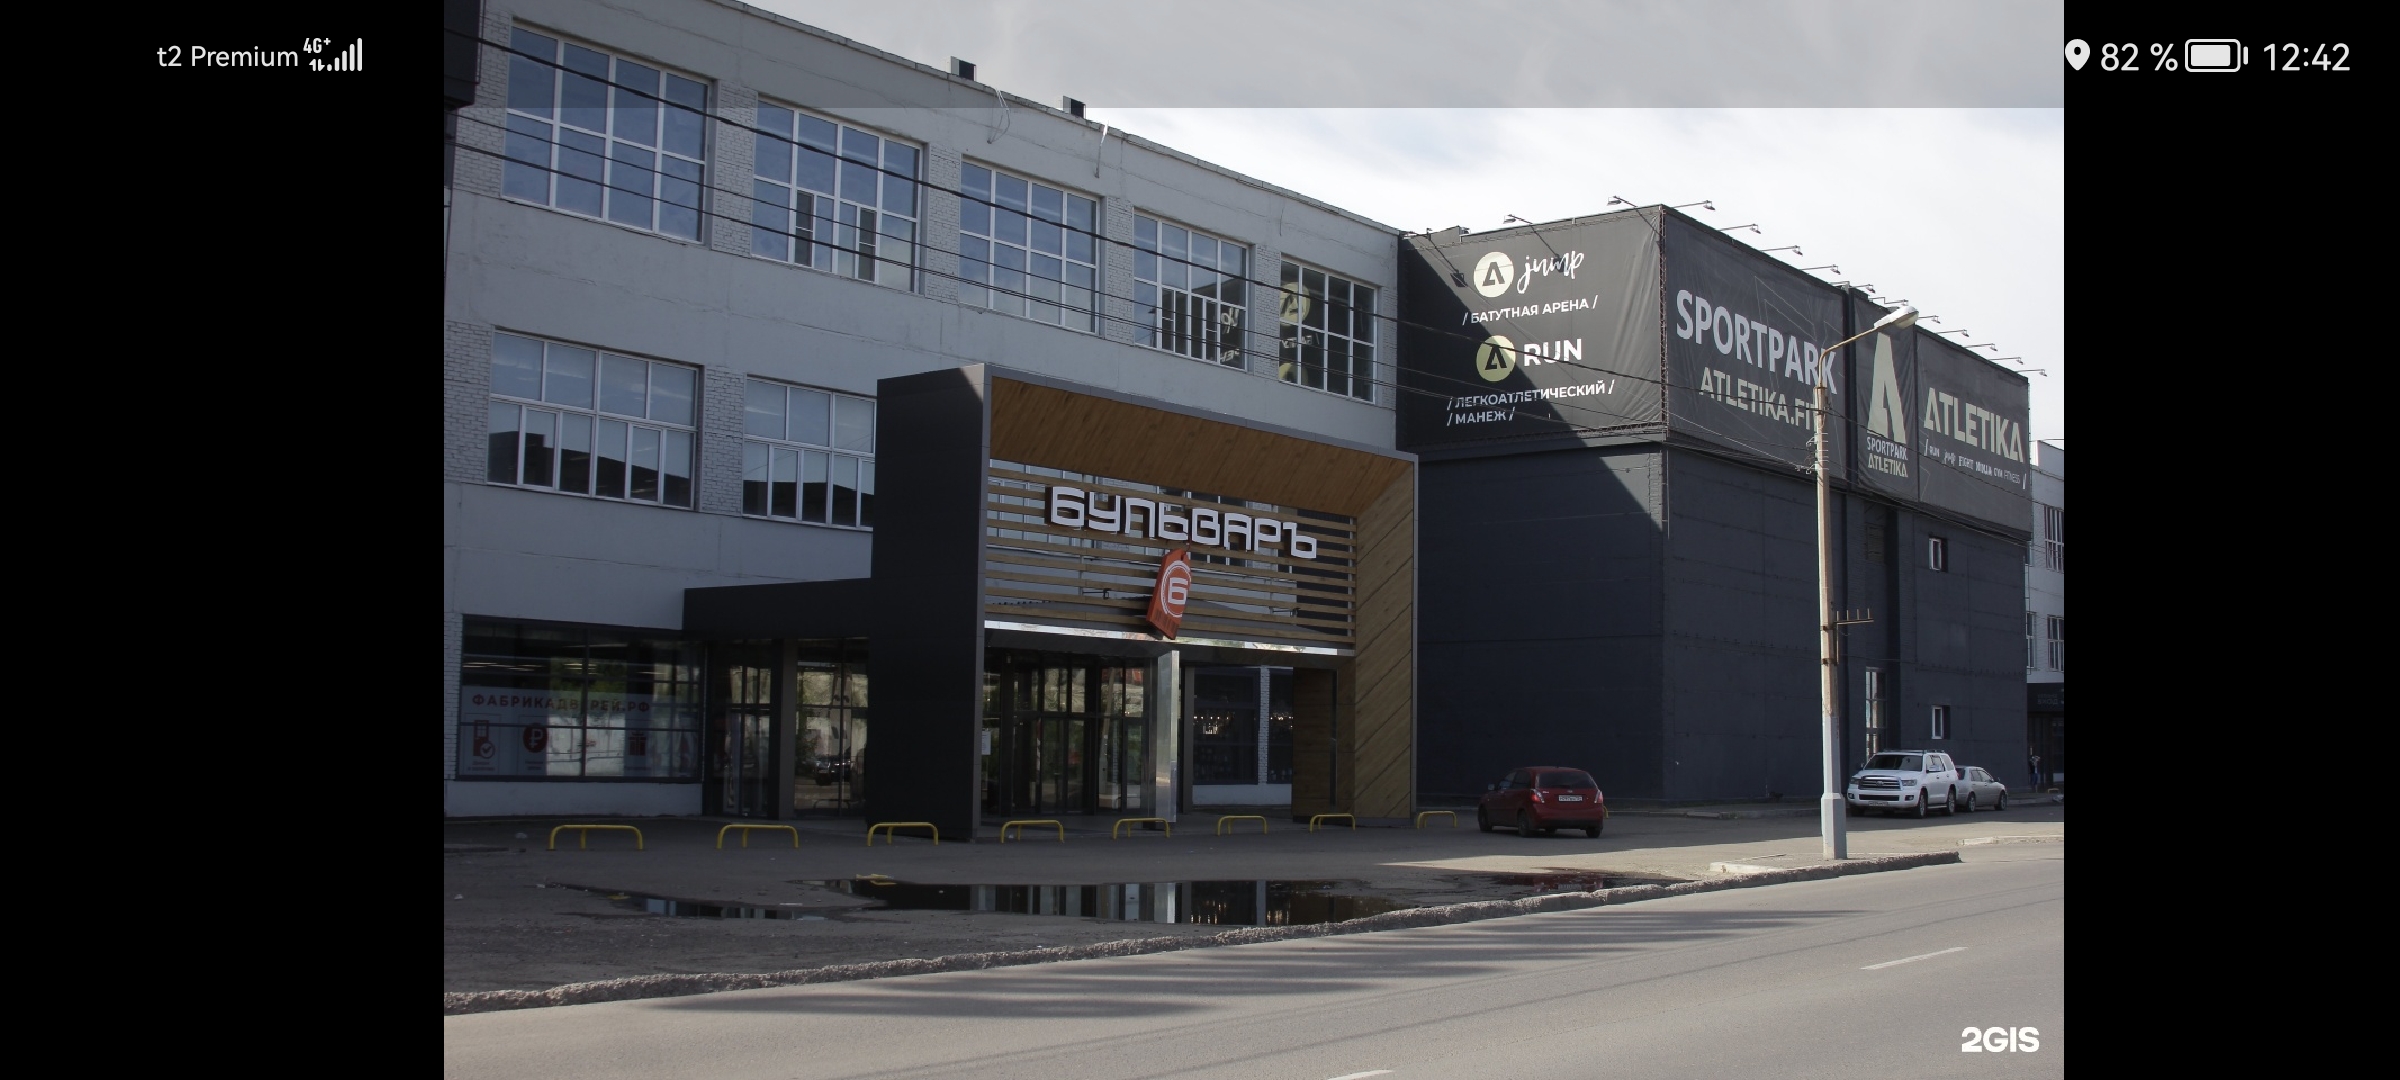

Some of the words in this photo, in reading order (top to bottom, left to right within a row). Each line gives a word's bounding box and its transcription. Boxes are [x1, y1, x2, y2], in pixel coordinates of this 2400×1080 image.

[1516, 250, 1585, 294] jump
[1471, 304, 1539, 324] БАТУТНАЯ
[1542, 298, 1589, 314] АРЕНА
[1523, 338, 1582, 367] RUN
[1676, 289, 1837, 395] SPORTPARK
[1455, 380, 1606, 408] ЛЕГКОАТЛЕТИЧЕСКИЙ
[1455, 409, 1507, 425] МАНЕЖ
[1923, 387, 2024, 463] ATLETIKA
[1866, 436, 1907, 460] SPORTPARK
[1868, 452, 1909, 477] ATLETIKA
[1050, 485, 1317, 559] БУЛЬВАРЪ
[472, 693, 651, 713] ФАБРИКАДВРЕЙ.РФ
